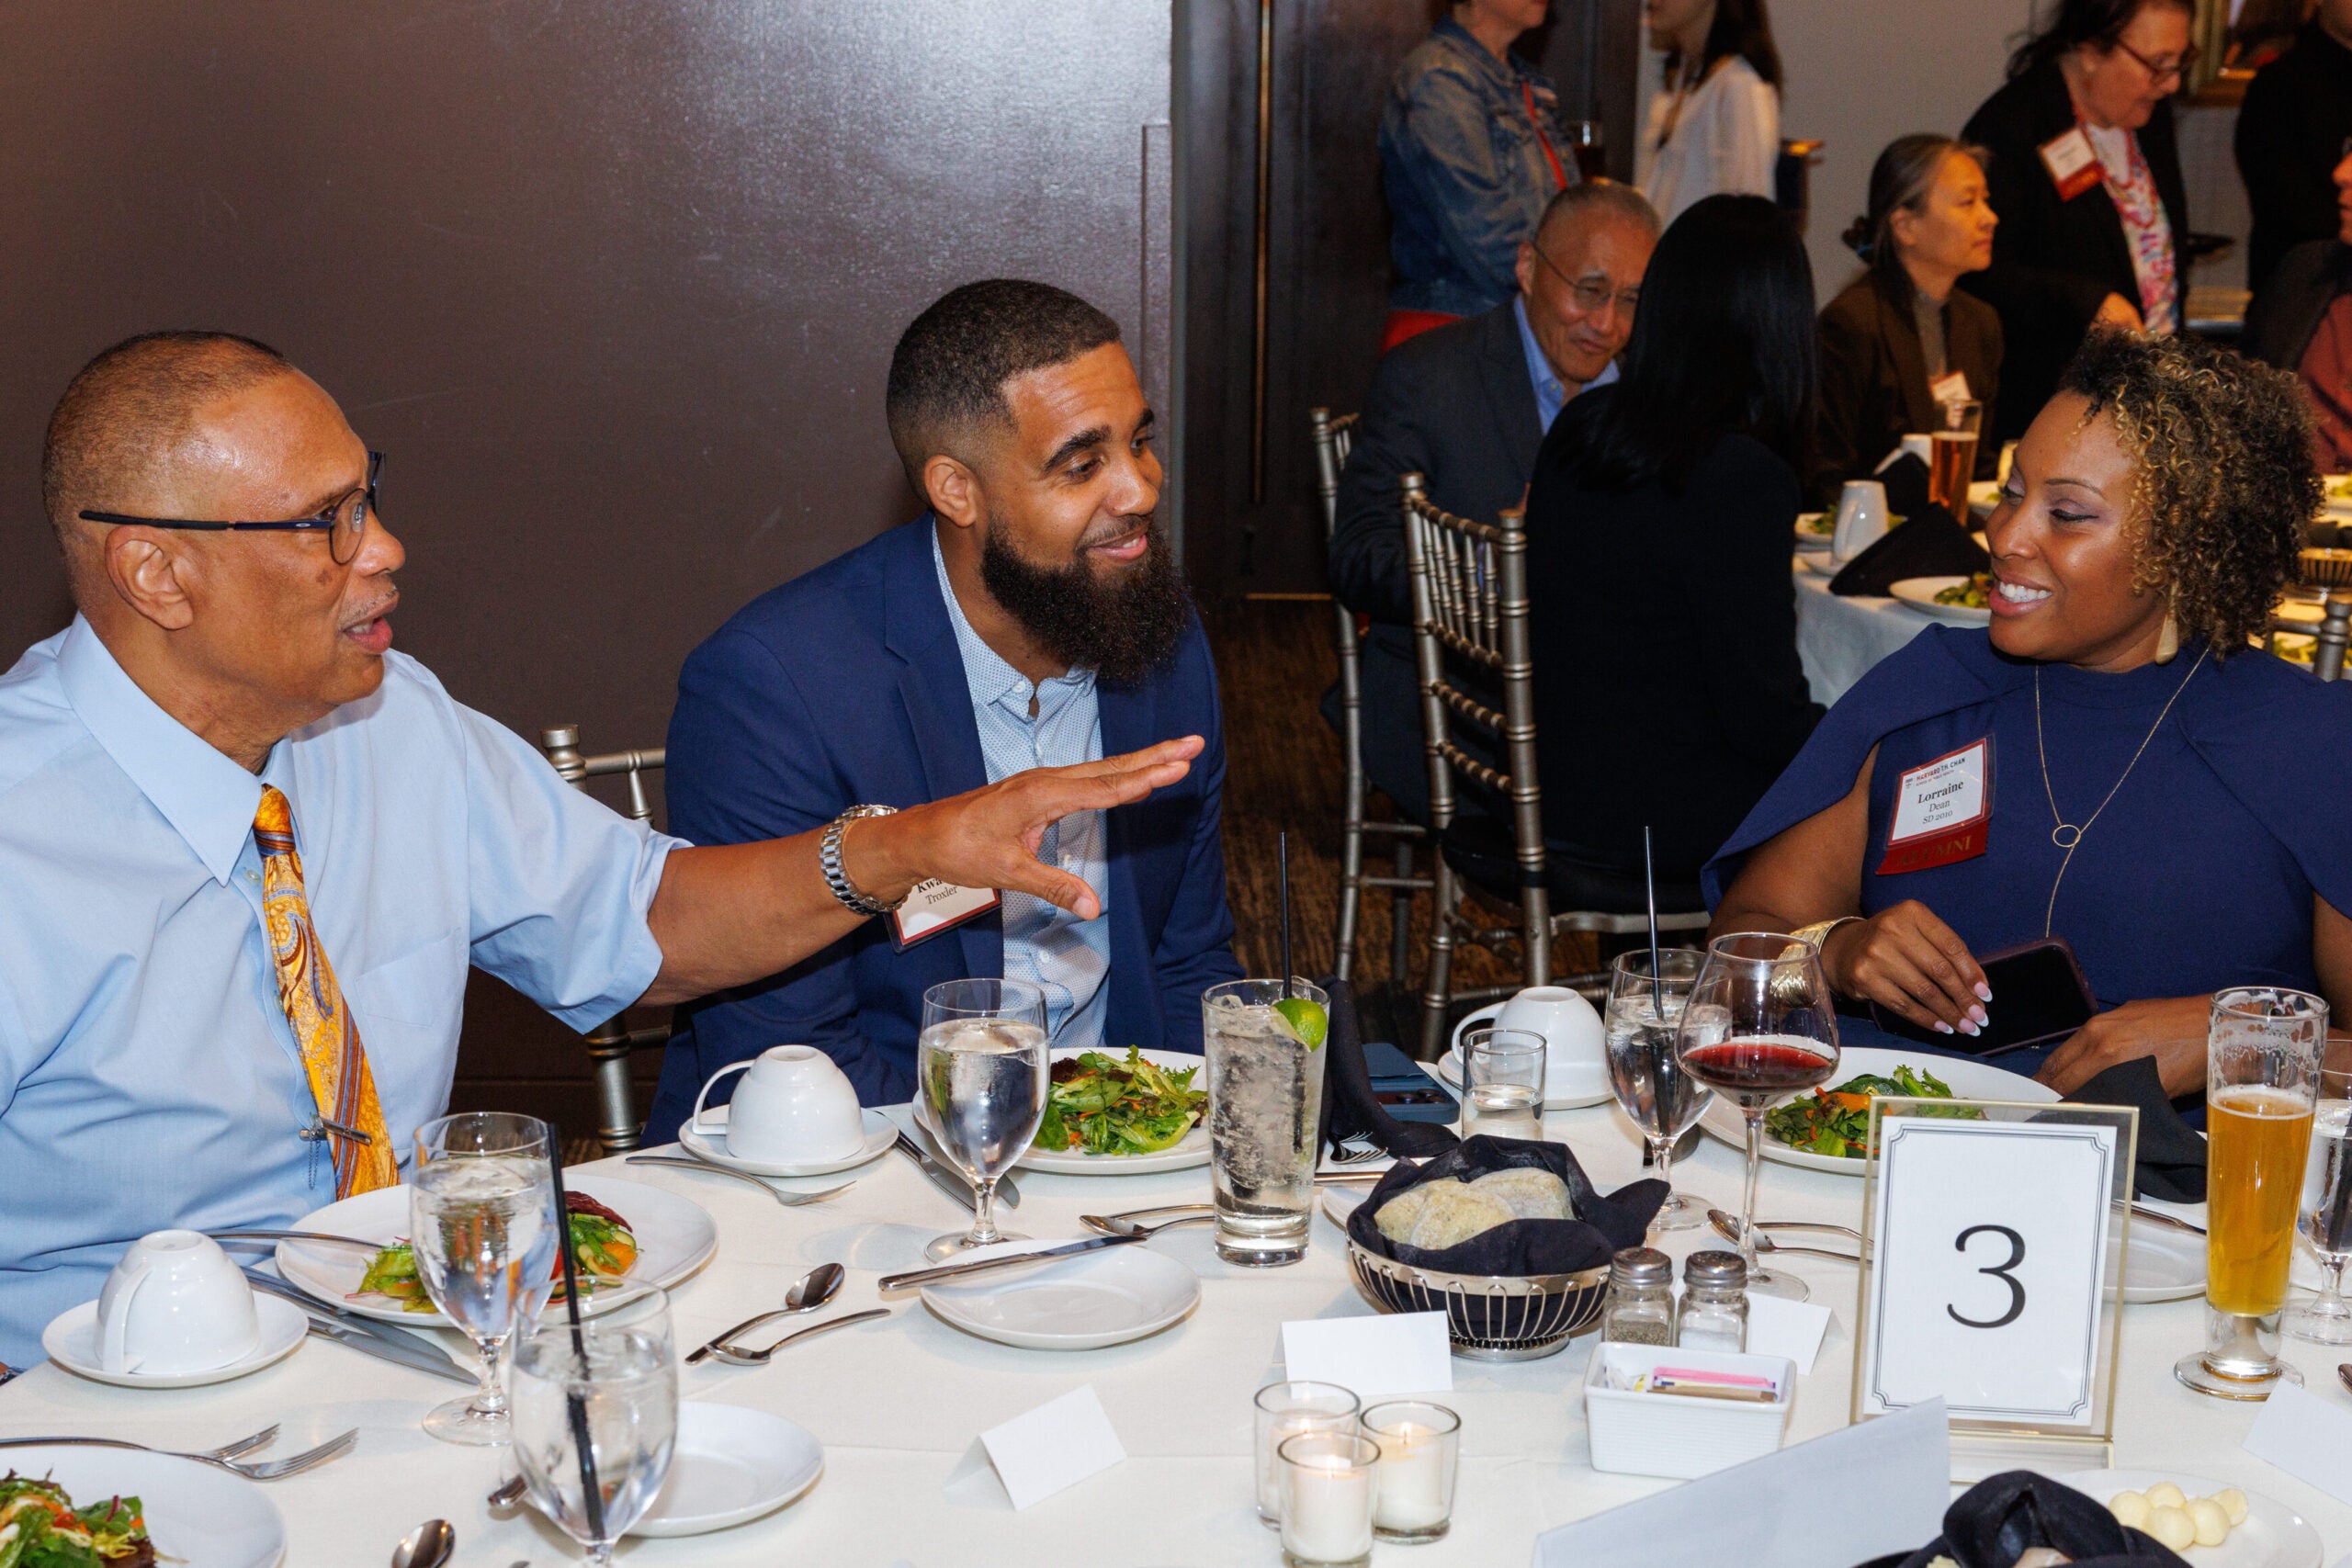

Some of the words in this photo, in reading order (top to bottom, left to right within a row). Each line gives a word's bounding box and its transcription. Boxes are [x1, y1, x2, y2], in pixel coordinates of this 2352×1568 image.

[1917, 782, 1963, 804] Lorraine
[1929, 800, 1951, 812] Dean
[1922, 814, 1934, 824] SD
[1935, 810, 1953, 821] 2010
[925, 886, 958, 905] Troxler
[1947, 1224, 2026, 1328] 3
